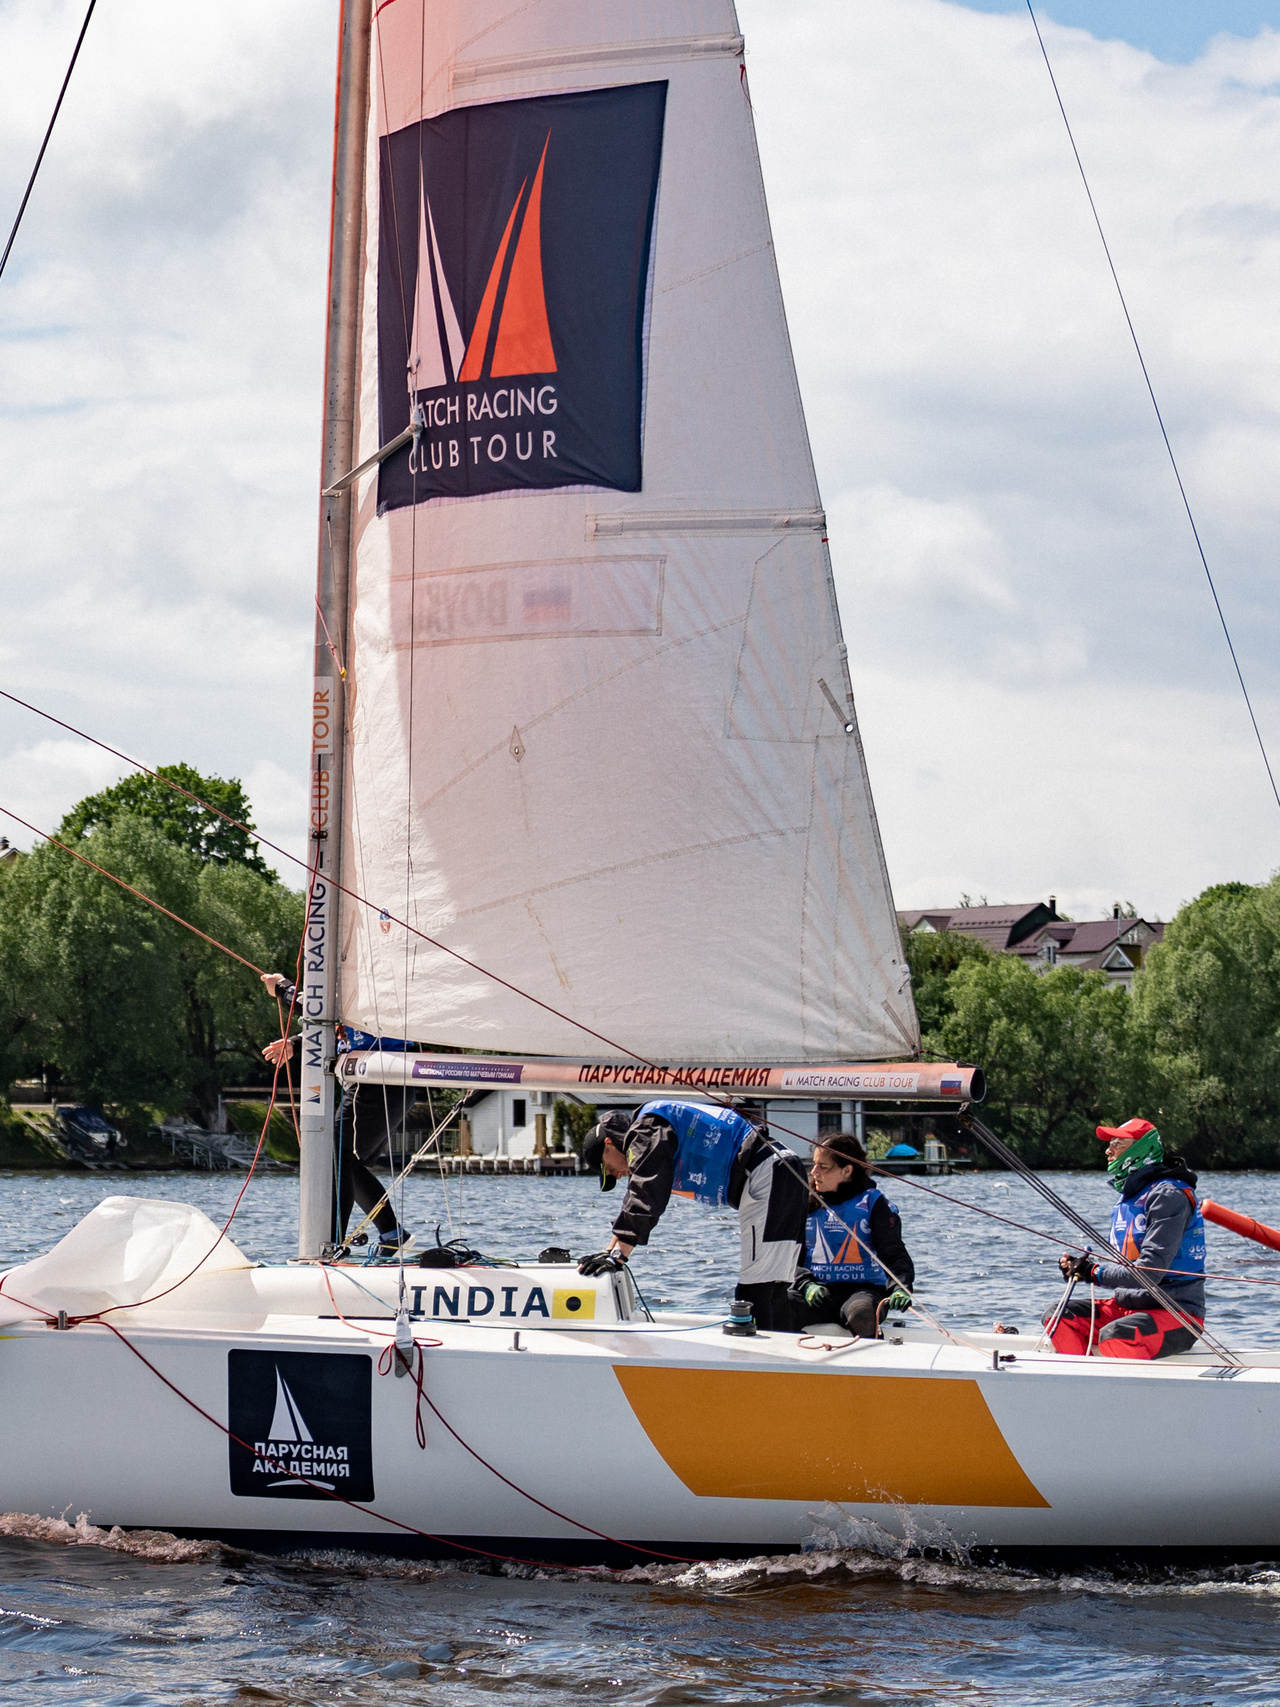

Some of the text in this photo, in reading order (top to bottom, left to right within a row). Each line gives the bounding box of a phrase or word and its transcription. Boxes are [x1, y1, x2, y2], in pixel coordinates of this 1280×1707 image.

[409, 385, 558, 429] ATCH RACING
[408, 430, 558, 475] CLUB TOUR
[312, 688, 330, 753] TOUR
[311, 769, 330, 828] CLUB
[308, 882, 327, 972] RACING
[578, 1065, 772, 1088] ПАРУСНАЯ АКАДЕМИЯ
[796, 1076, 914, 1088] MATCH RACING CLUB TOUR
[834, 1264, 865, 1272] RACING
[835, 1272, 866, 1280] TOUR
[409, 1286, 550, 1318] INDIA
[254, 1442, 348, 1461] ПАРУСНАЯ
[252, 1459, 351, 1478] АКАДЕМИЯ
